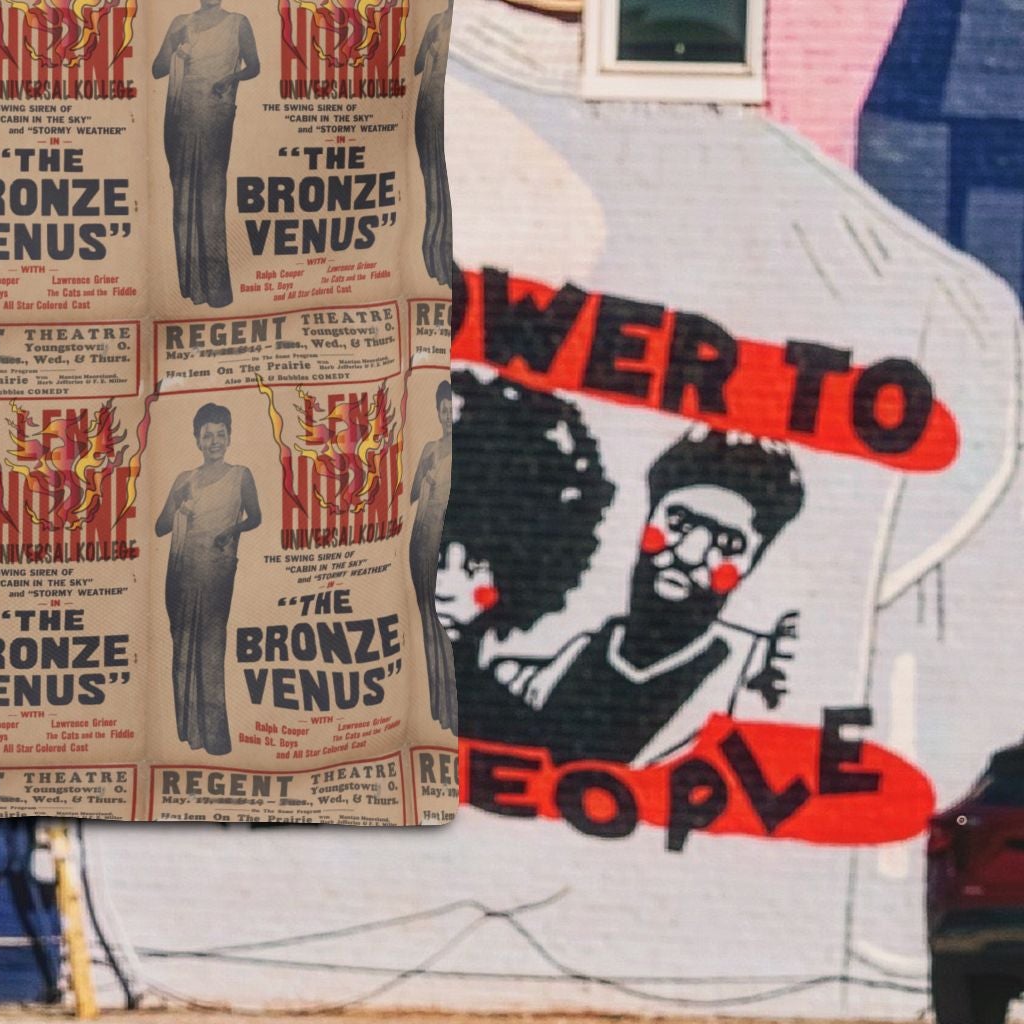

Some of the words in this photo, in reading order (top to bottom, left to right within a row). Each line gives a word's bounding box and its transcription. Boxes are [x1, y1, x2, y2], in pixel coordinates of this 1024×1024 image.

[279, 79, 354, 99] UNIVERSAL
[8, 126, 24, 134] and
[316, 125, 355, 133] "STORMY
[361, 124, 398, 132] WEATHER"
[278, 146, 365, 170] "THE
[236, 172, 395, 213] BRONZE
[245, 212, 396, 256] VENUS"
[307, 257, 326, 265] WITH
[52, 276, 90, 284] Lawrence
[62, 288, 80, 296] Cats
[16, 301, 34, 310] Star
[36, 301, 68, 310] Colored
[72, 300, 90, 309] Cast
[25, 328, 130, 341] THEATRE
[166, 317, 287, 350] REGENT
[301, 308, 393, 325] THEATRE
[34, 354, 70, 364] Wed.,
[91, 354, 130, 362] Thurs.
[786, 340, 934, 455] TO
[264, 555, 282, 563] THE
[285, 554, 314, 562] SWING
[318, 552, 342, 561] SIREN
[344, 551, 355, 559] OF
[62, 568, 74, 576] OF
[286, 564, 317, 573] "CABIN
[319, 563, 328, 571] IN
[331, 561, 350, 570] THE
[351, 559, 368, 568] SKY"
[69, 578, 93, 586] SKY"
[9, 590, 24, 598] and
[28, 590, 72, 598] "STORMY
[78, 588, 128, 596] WEATHER"
[277, 589, 352, 616] "THE
[236, 613, 401, 664] BRONZE
[244, 659, 402, 711] VENUS"
[20, 710, 44, 718] WITH
[311, 716, 333, 725] WITH
[24, 771, 128, 784] THEATRE
[162, 770, 293, 797] REGENT
[311, 762, 397, 785] THEATRE
